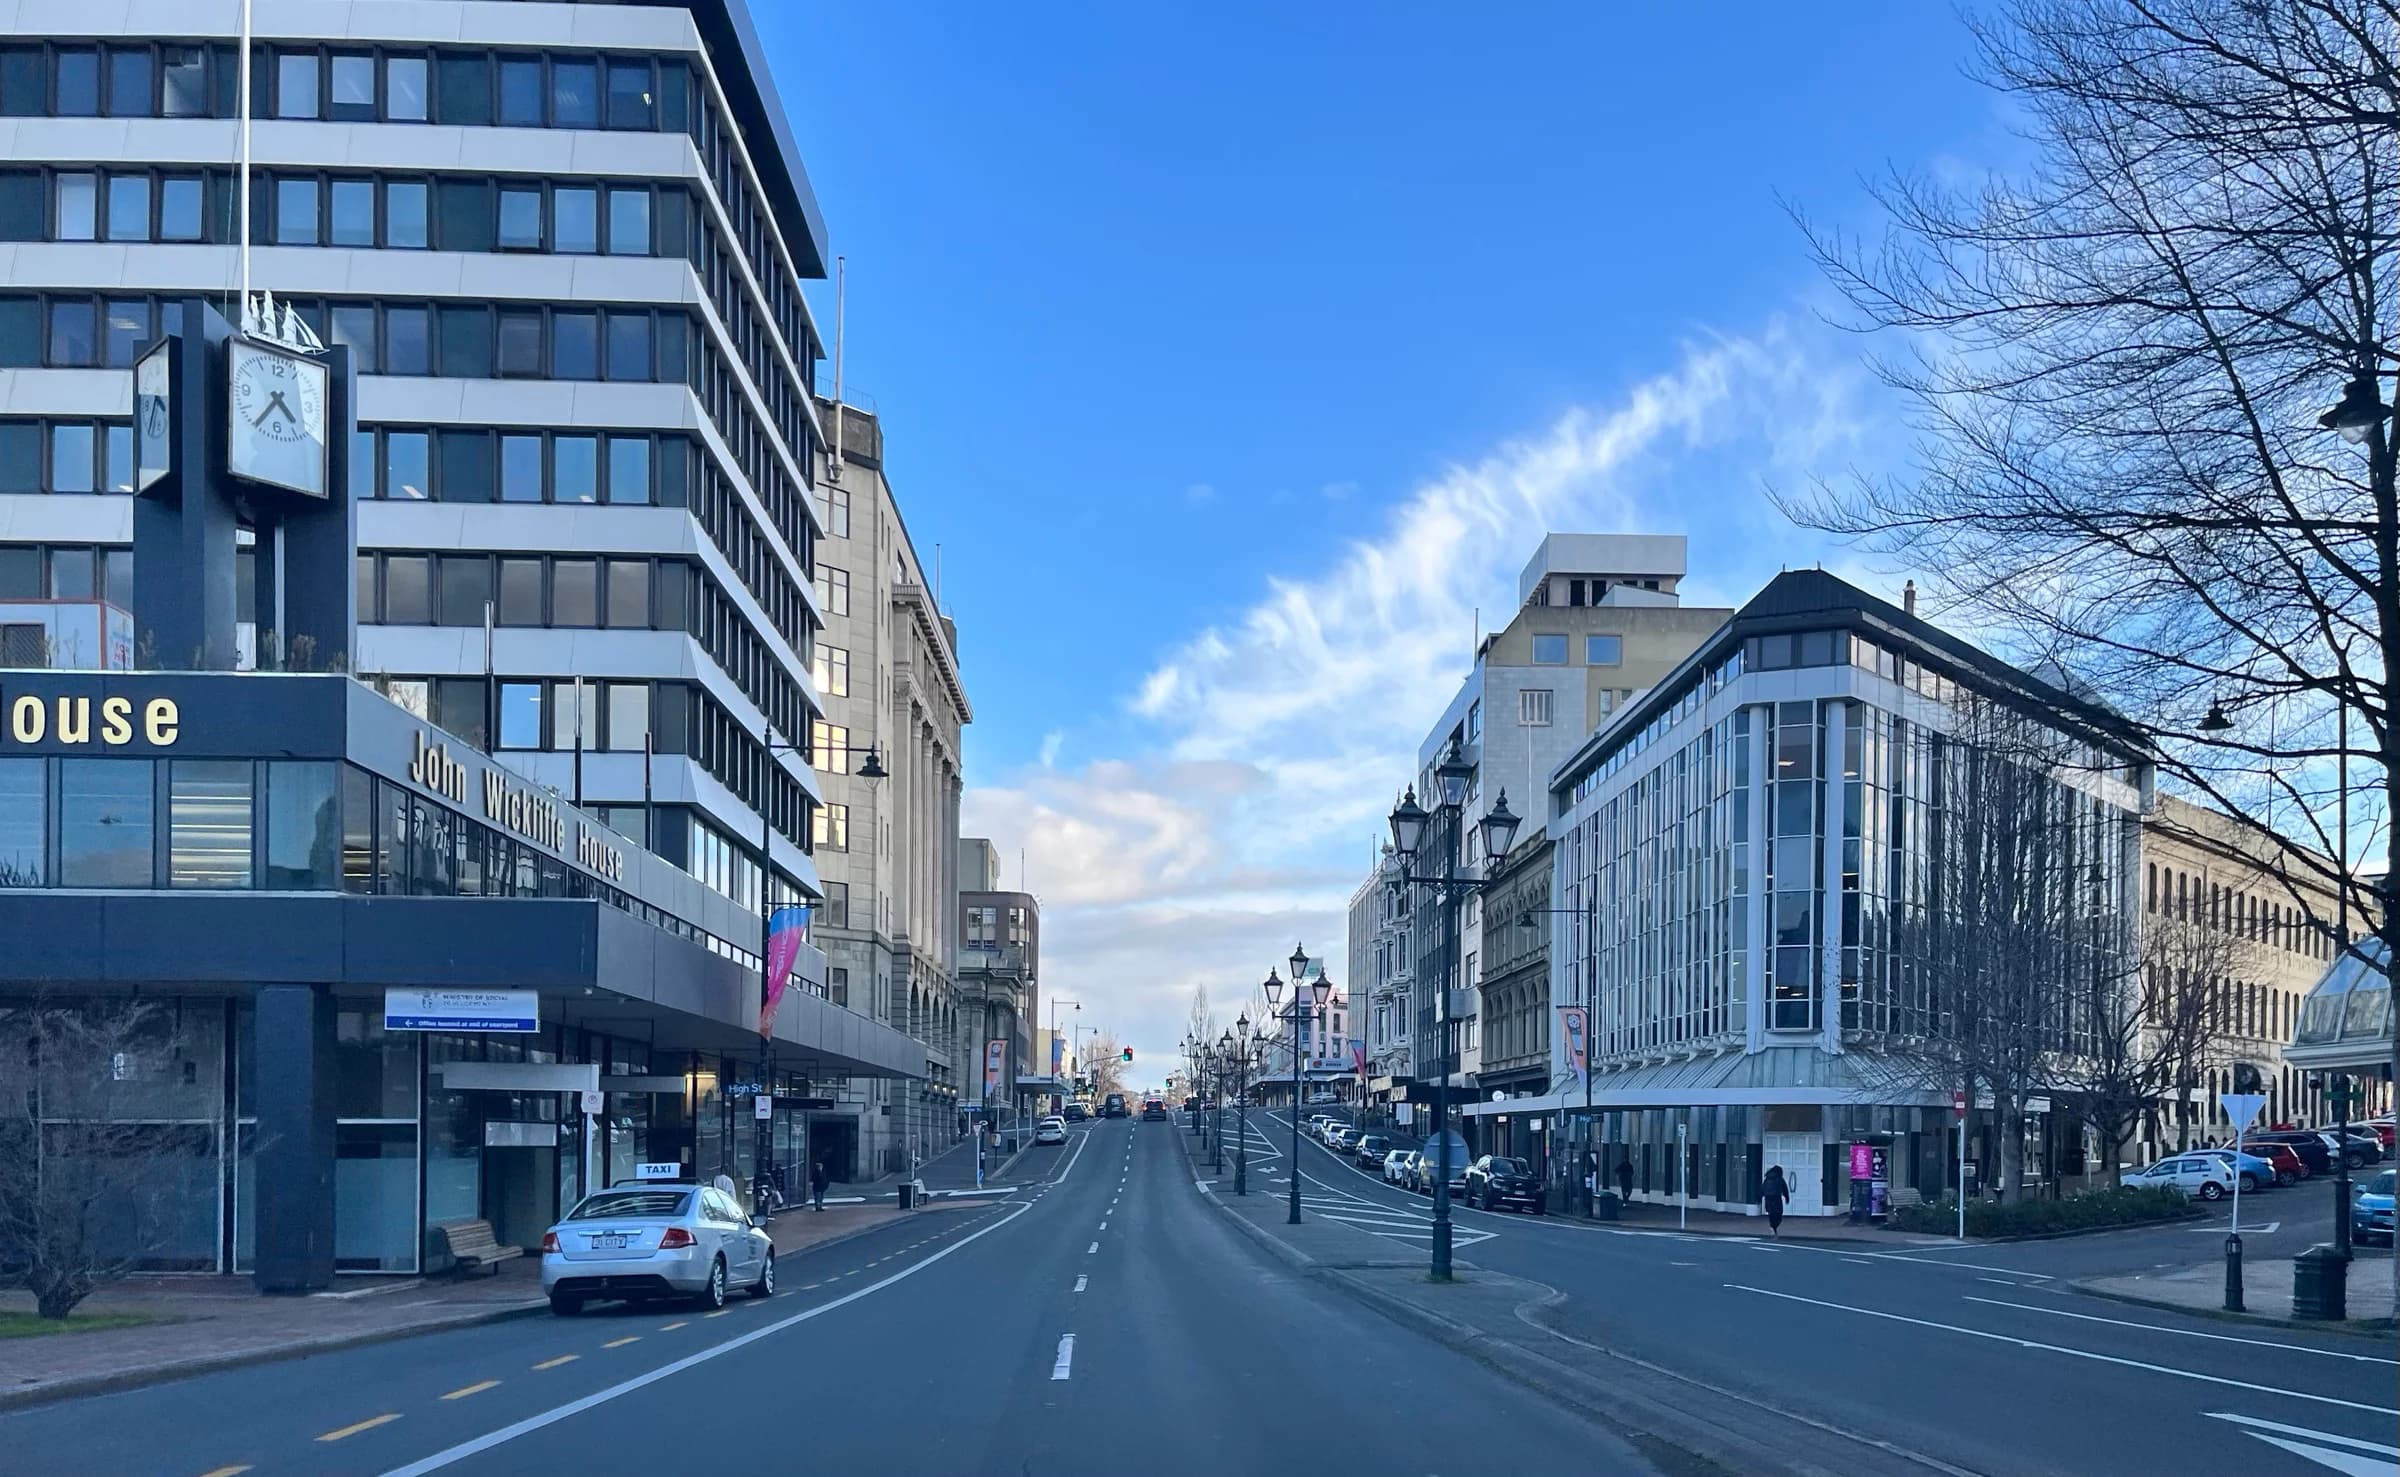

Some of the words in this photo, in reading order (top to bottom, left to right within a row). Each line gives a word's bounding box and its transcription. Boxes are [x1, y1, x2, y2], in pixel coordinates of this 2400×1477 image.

[272, 365, 285, 378] 12
[241, 384, 251, 397] 9
[304, 401, 313, 414] 3
[273, 421, 282, 433] 6
[12, 695, 179, 746] ouse
[412, 729, 467, 804] John
[484, 767, 566, 854] Wickliffe
[577, 820, 624, 882] House
[728, 1084, 749, 1096] High
[751, 1082, 763, 1093] St
[645, 1165, 671, 1174] TAXI
